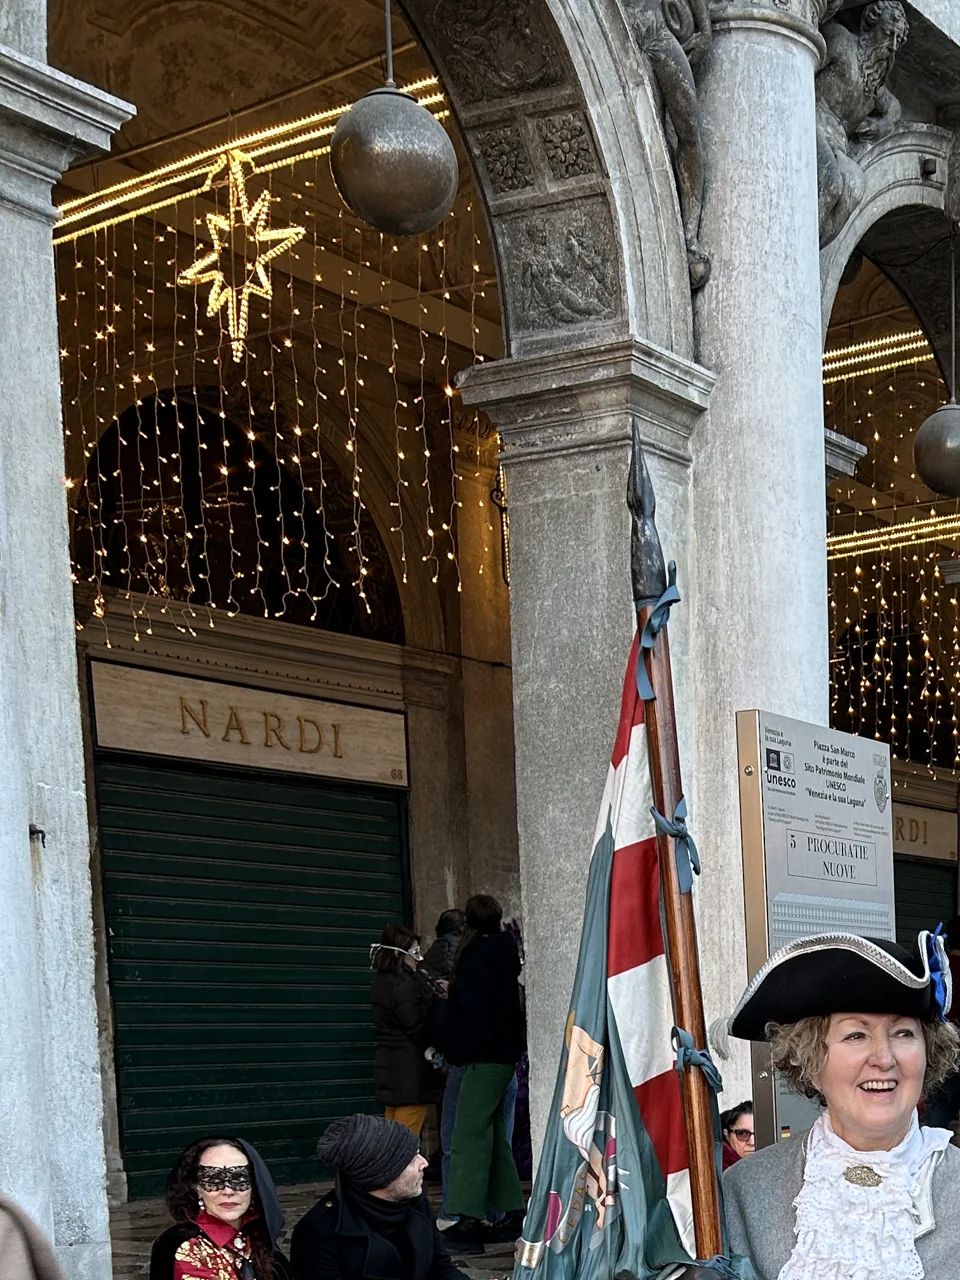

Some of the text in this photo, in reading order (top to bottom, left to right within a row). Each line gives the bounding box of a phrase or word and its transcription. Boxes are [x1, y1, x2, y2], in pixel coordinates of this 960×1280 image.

[179, 697, 343, 758] NARDI
[777, 736, 792, 747] Laguna
[813, 740, 856, 758] Piazza San Marco
[822, 754, 848, 768] è parte del
[766, 773, 796, 788] unesco
[804, 762, 866, 784] Sito Patrimonio Mondiale
[826, 780, 846, 792] UNESCO
[805, 787, 828, 800] "Venezia
[832, 792, 837, 802] la
[847, 796, 866, 808] Laguna"
[894, 816, 928, 844] RDI
[790, 834, 868, 860] 5 PROCURATIE
[823, 861, 856, 880] NUOVE
